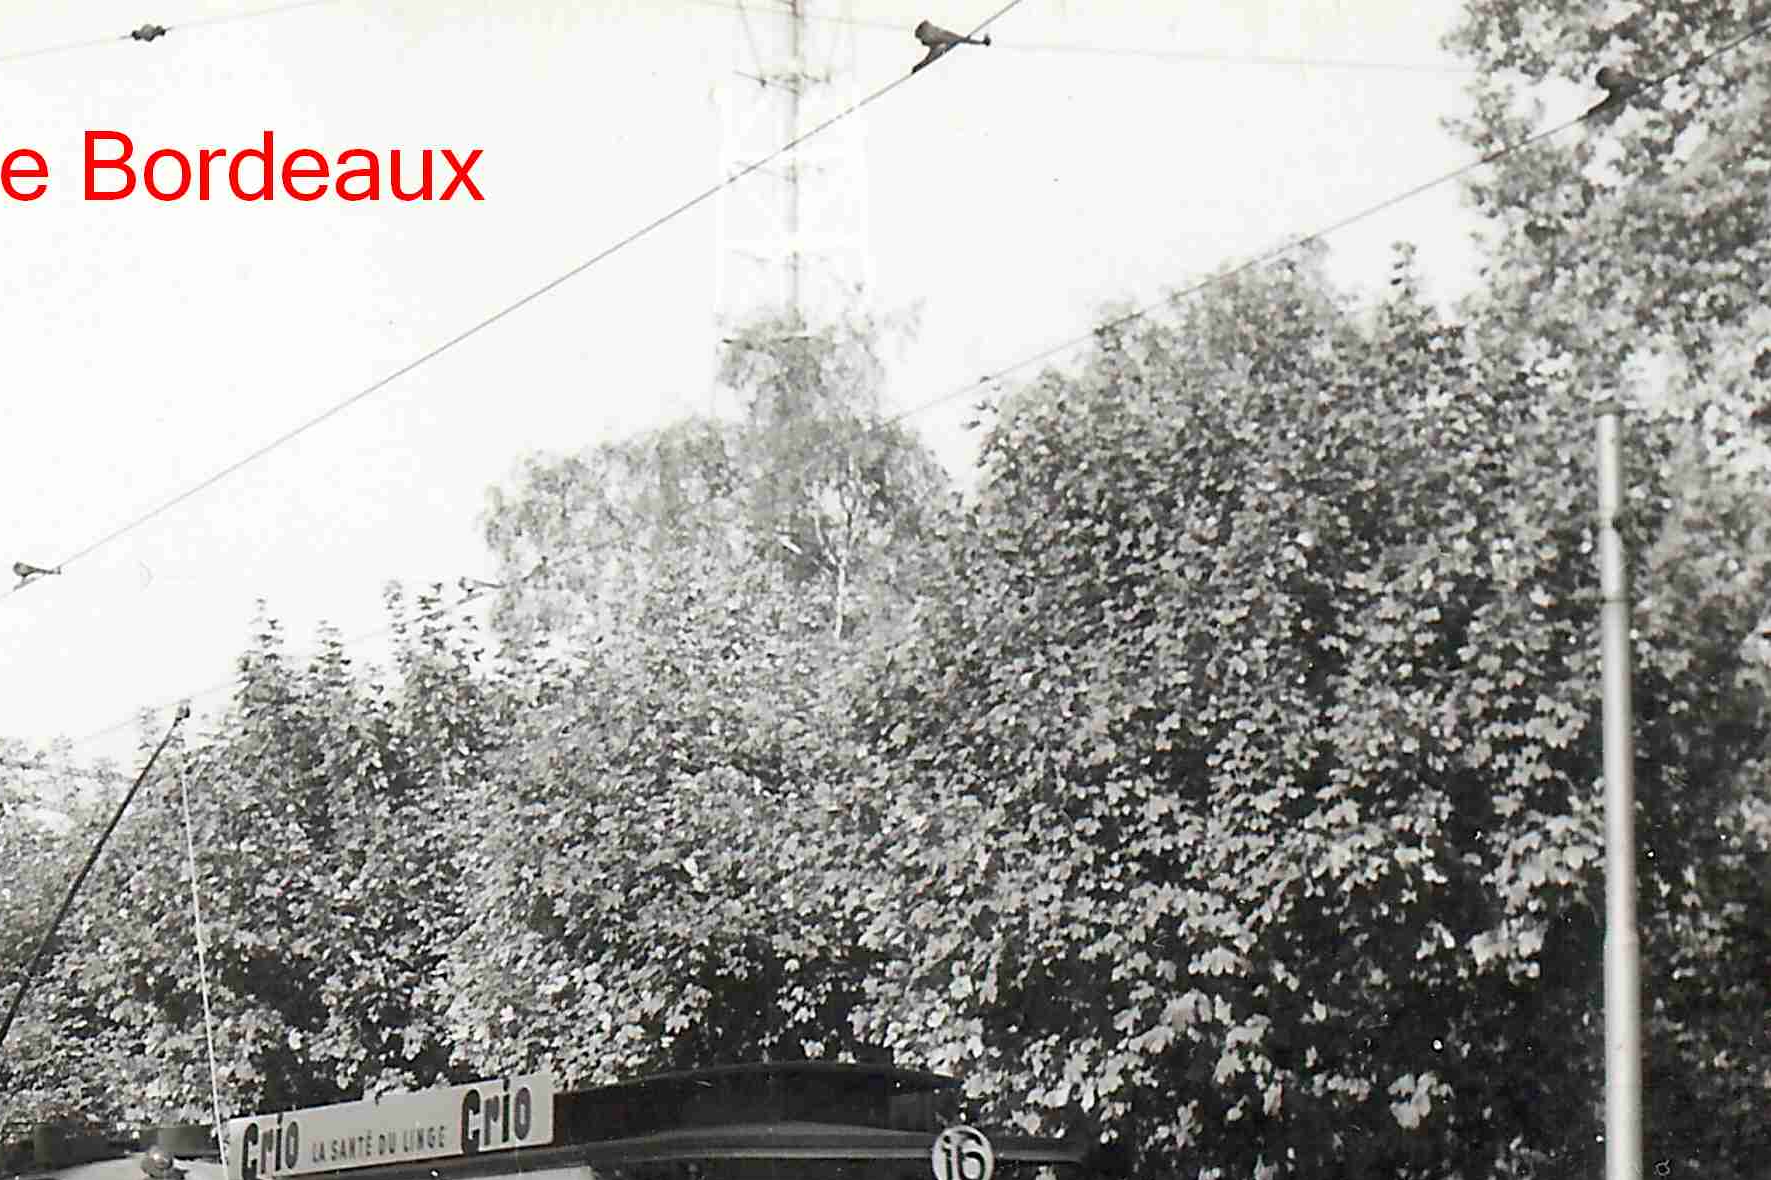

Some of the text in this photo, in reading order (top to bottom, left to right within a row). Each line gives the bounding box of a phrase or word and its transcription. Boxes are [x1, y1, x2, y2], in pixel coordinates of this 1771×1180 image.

[311, 1139, 326, 1162] LA
[331, 1128, 373, 1161] SANTÉ
[378, 1132, 397, 1156] DU
[402, 1124, 445, 1153] LINGE
[462, 1077, 531, 1157] Crio
